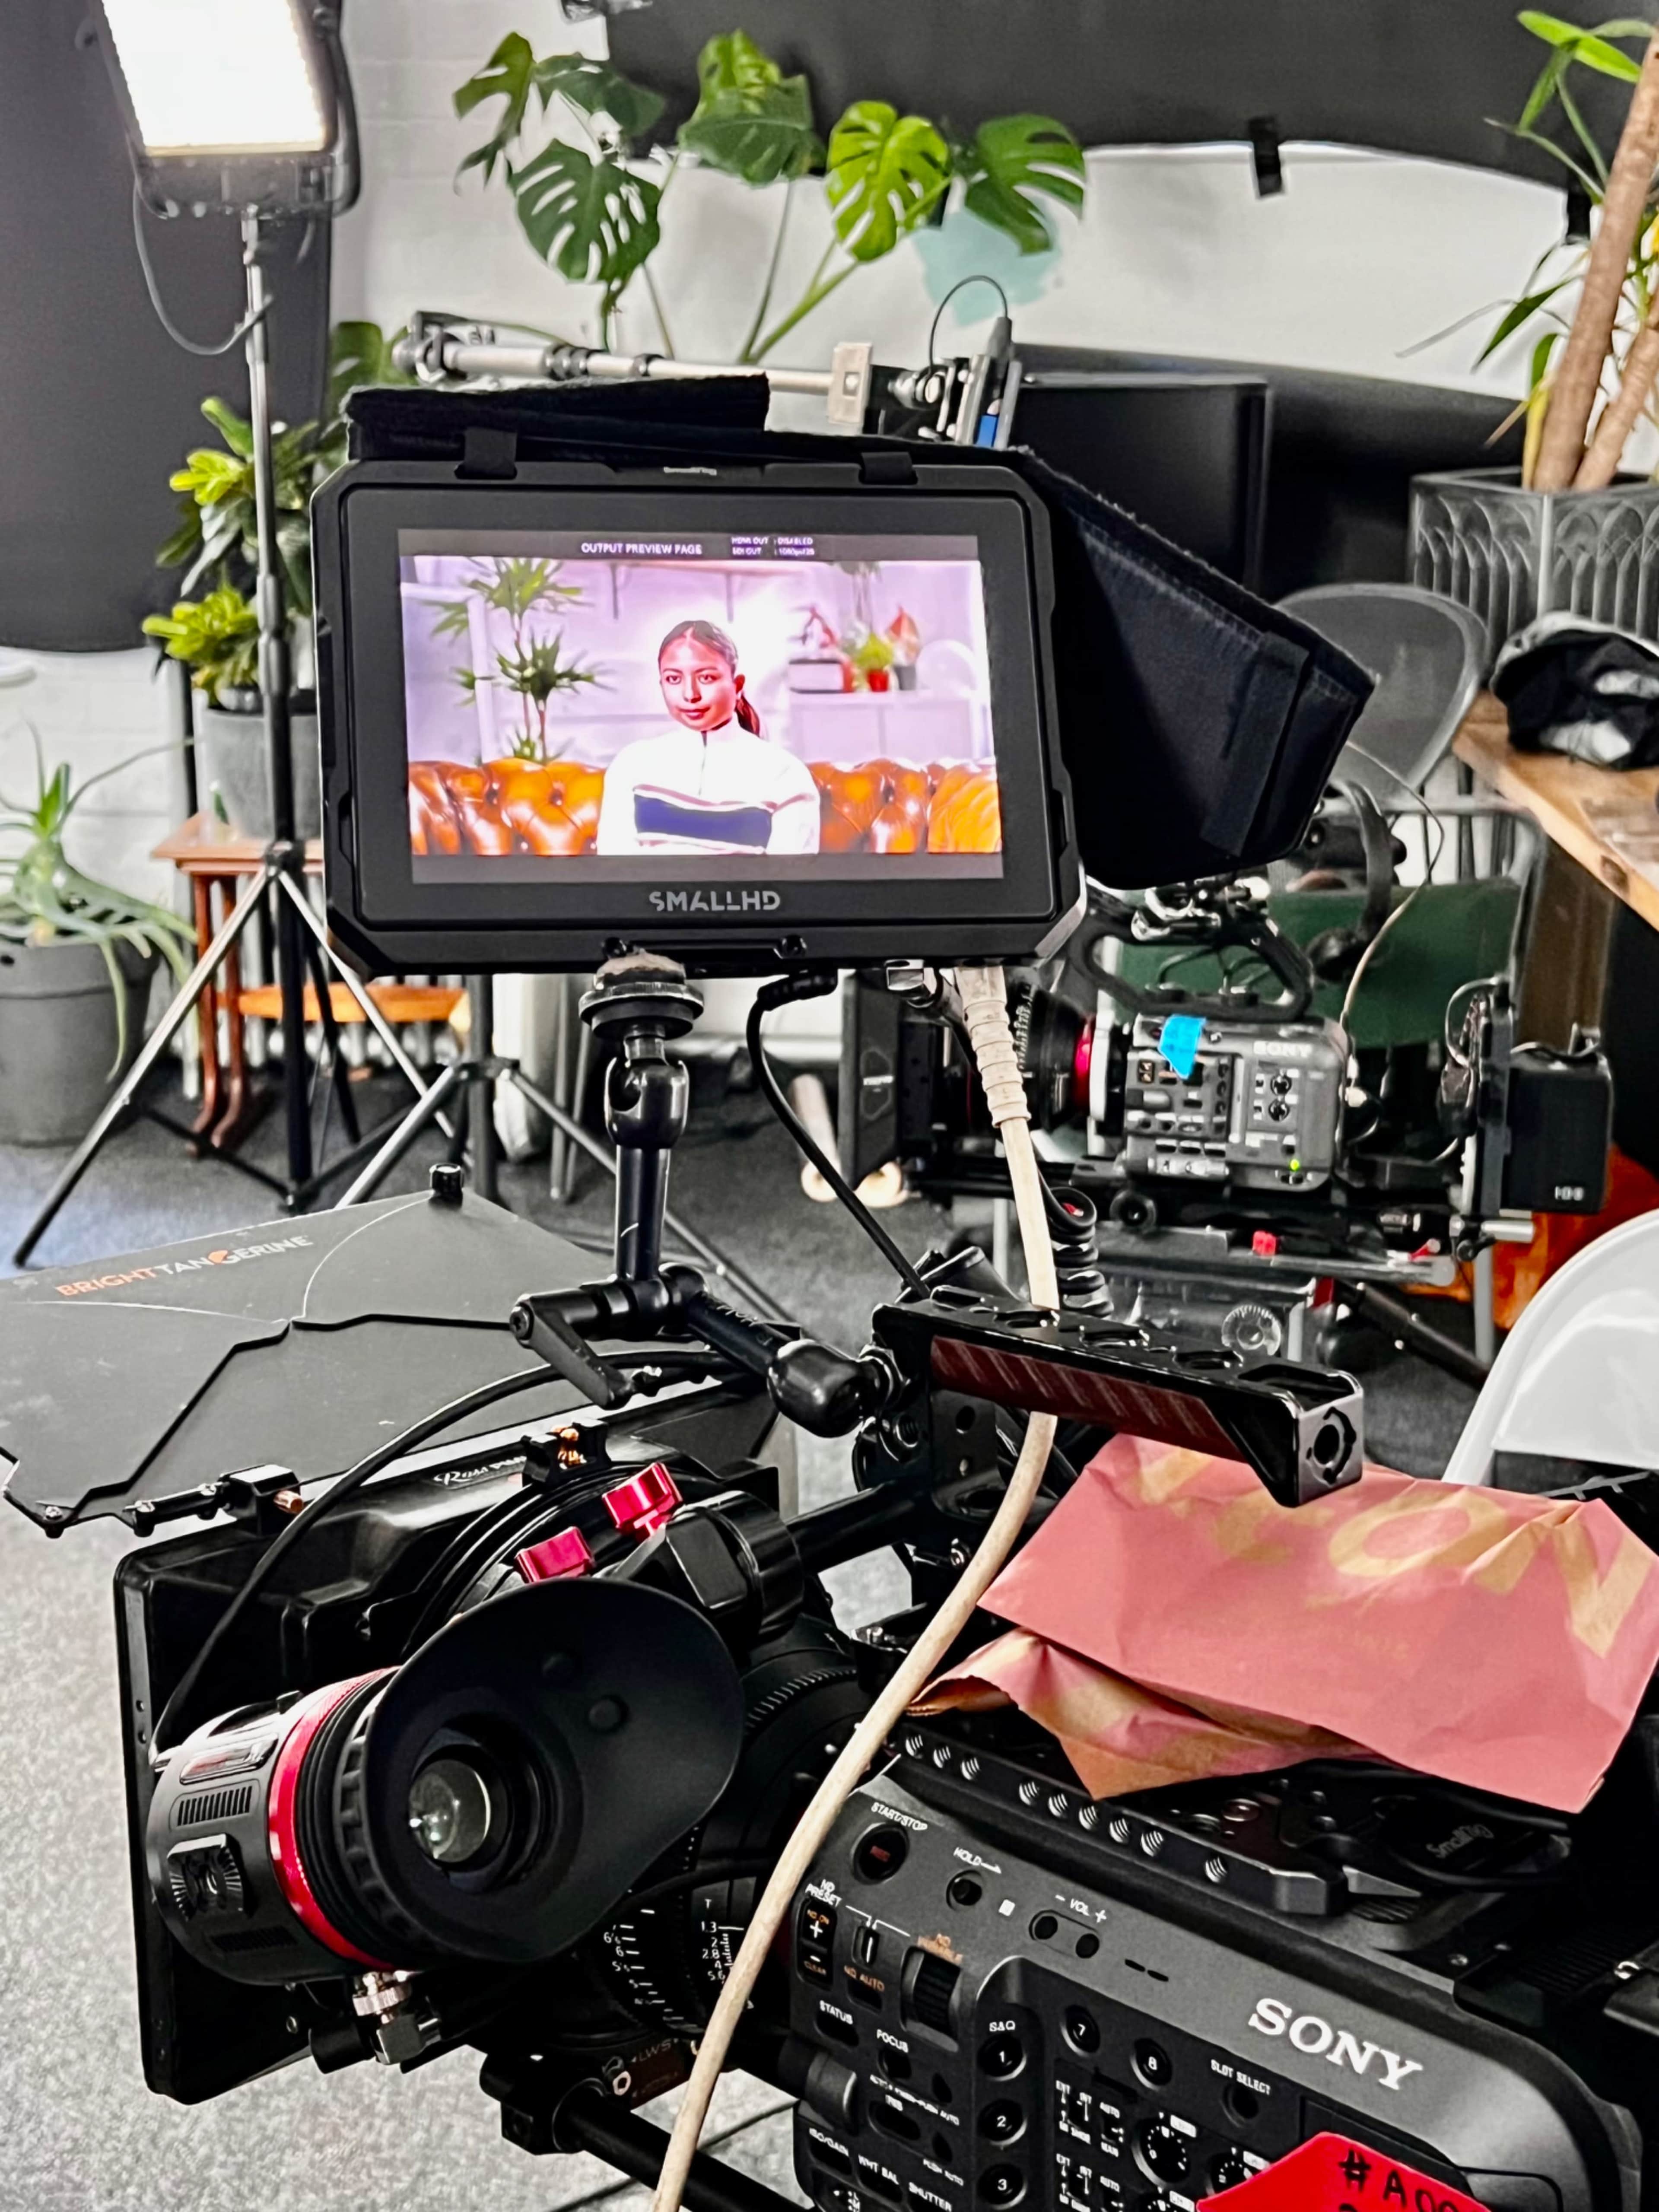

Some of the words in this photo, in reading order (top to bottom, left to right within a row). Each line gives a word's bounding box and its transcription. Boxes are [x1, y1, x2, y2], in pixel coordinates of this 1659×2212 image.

[581, 543, 623, 554] OUTPUT
[625, 543, 672, 555] PREVIEW
[674, 544, 702, 555] PAGE
[753, 536, 769, 545] OUT
[746, 547, 762, 556] OUT
[648, 890, 781, 912] SMALLHD
[871, 1802, 928, 1831] START/STOP
[953, 1847, 982, 1866] HOLD
[1070, 1898, 1090, 1916] VOL
[820, 2000, 853, 2024] STATUS
[1078, 2023, 1086, 2036] 7
[877, 2029, 908, 2053] FOCUS
[1248, 1997, 1424, 2091] SONY
[999, 2050, 1005, 2063] 1
[1211, 2059, 1234, 2078] SLOT
[1236, 2071, 1271, 2095] SELECT
[996, 2115, 1007, 2127] 2
[998, 2178, 1008, 2190] 3
[909, 2181, 952, 2212] SHUTTER
